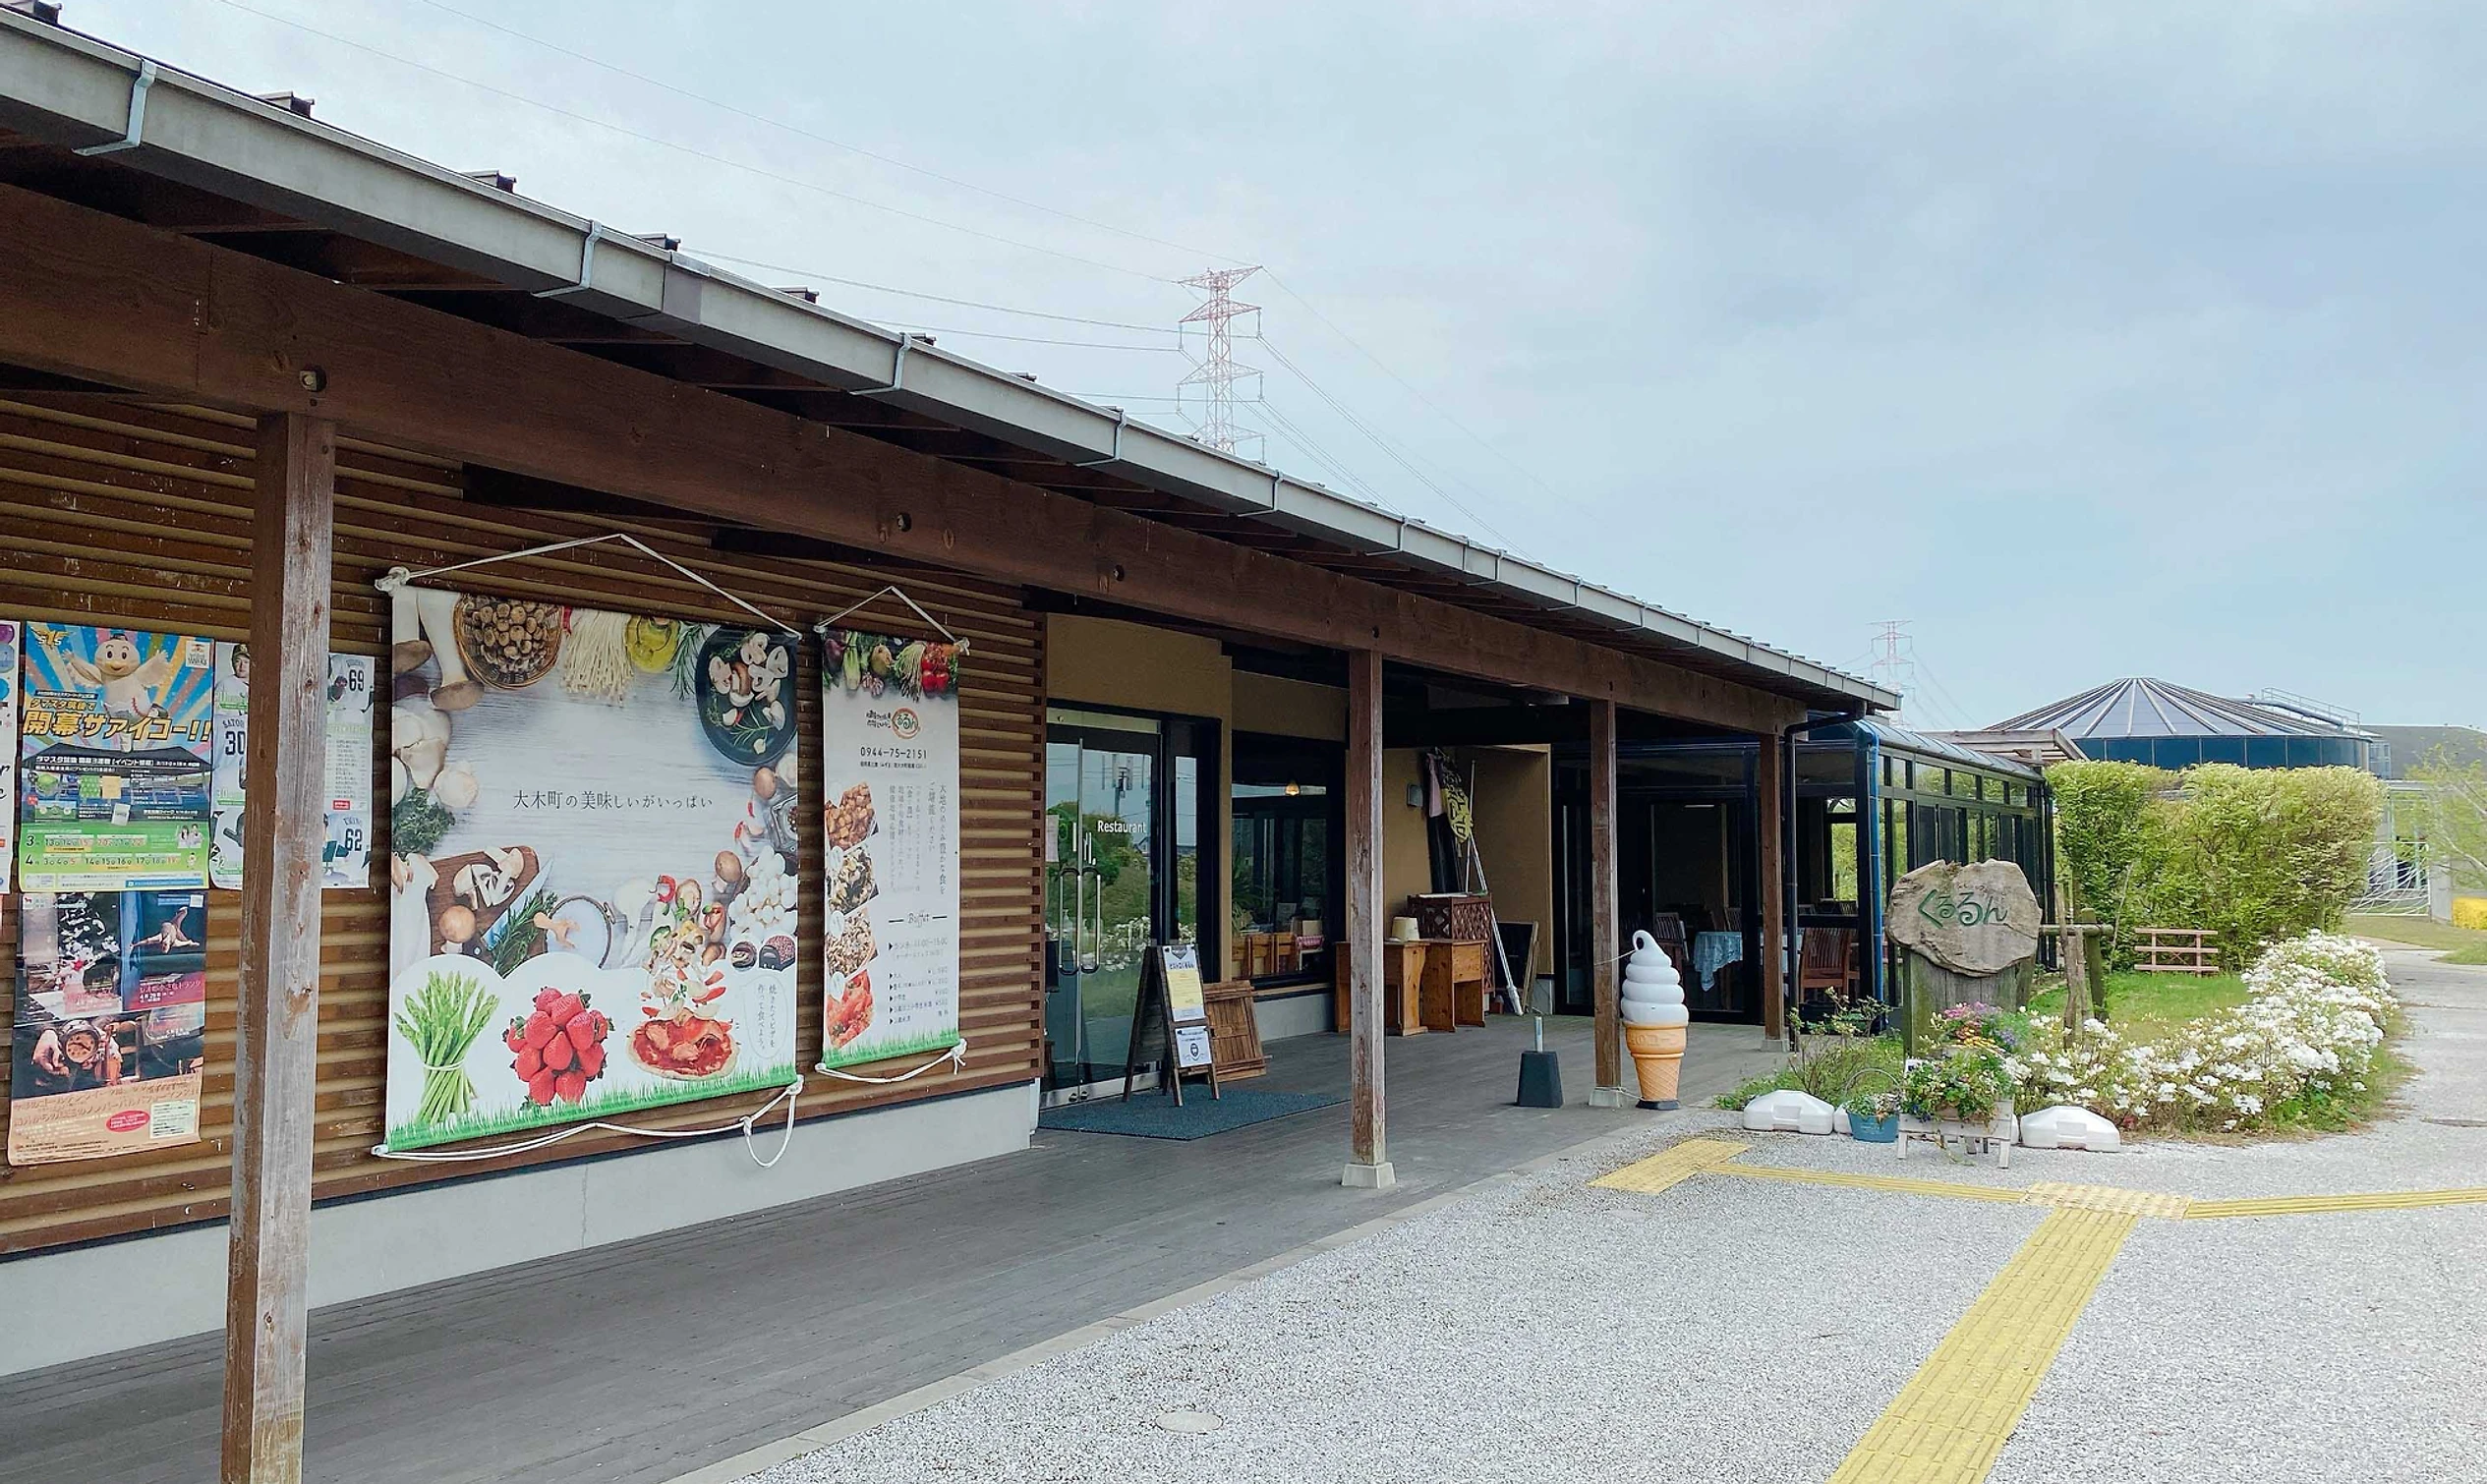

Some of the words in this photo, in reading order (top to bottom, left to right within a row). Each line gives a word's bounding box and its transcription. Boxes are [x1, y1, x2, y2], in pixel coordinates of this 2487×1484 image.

[349, 669, 365, 692] 69
[222, 718, 245, 729] SATO
[512, 789, 713, 811] 大木町の美味しいがいっぱい
[1097, 820, 1146, 833] Restaurant
[345, 828, 364, 852] 62
[1917, 888, 2008, 929] くるるん
